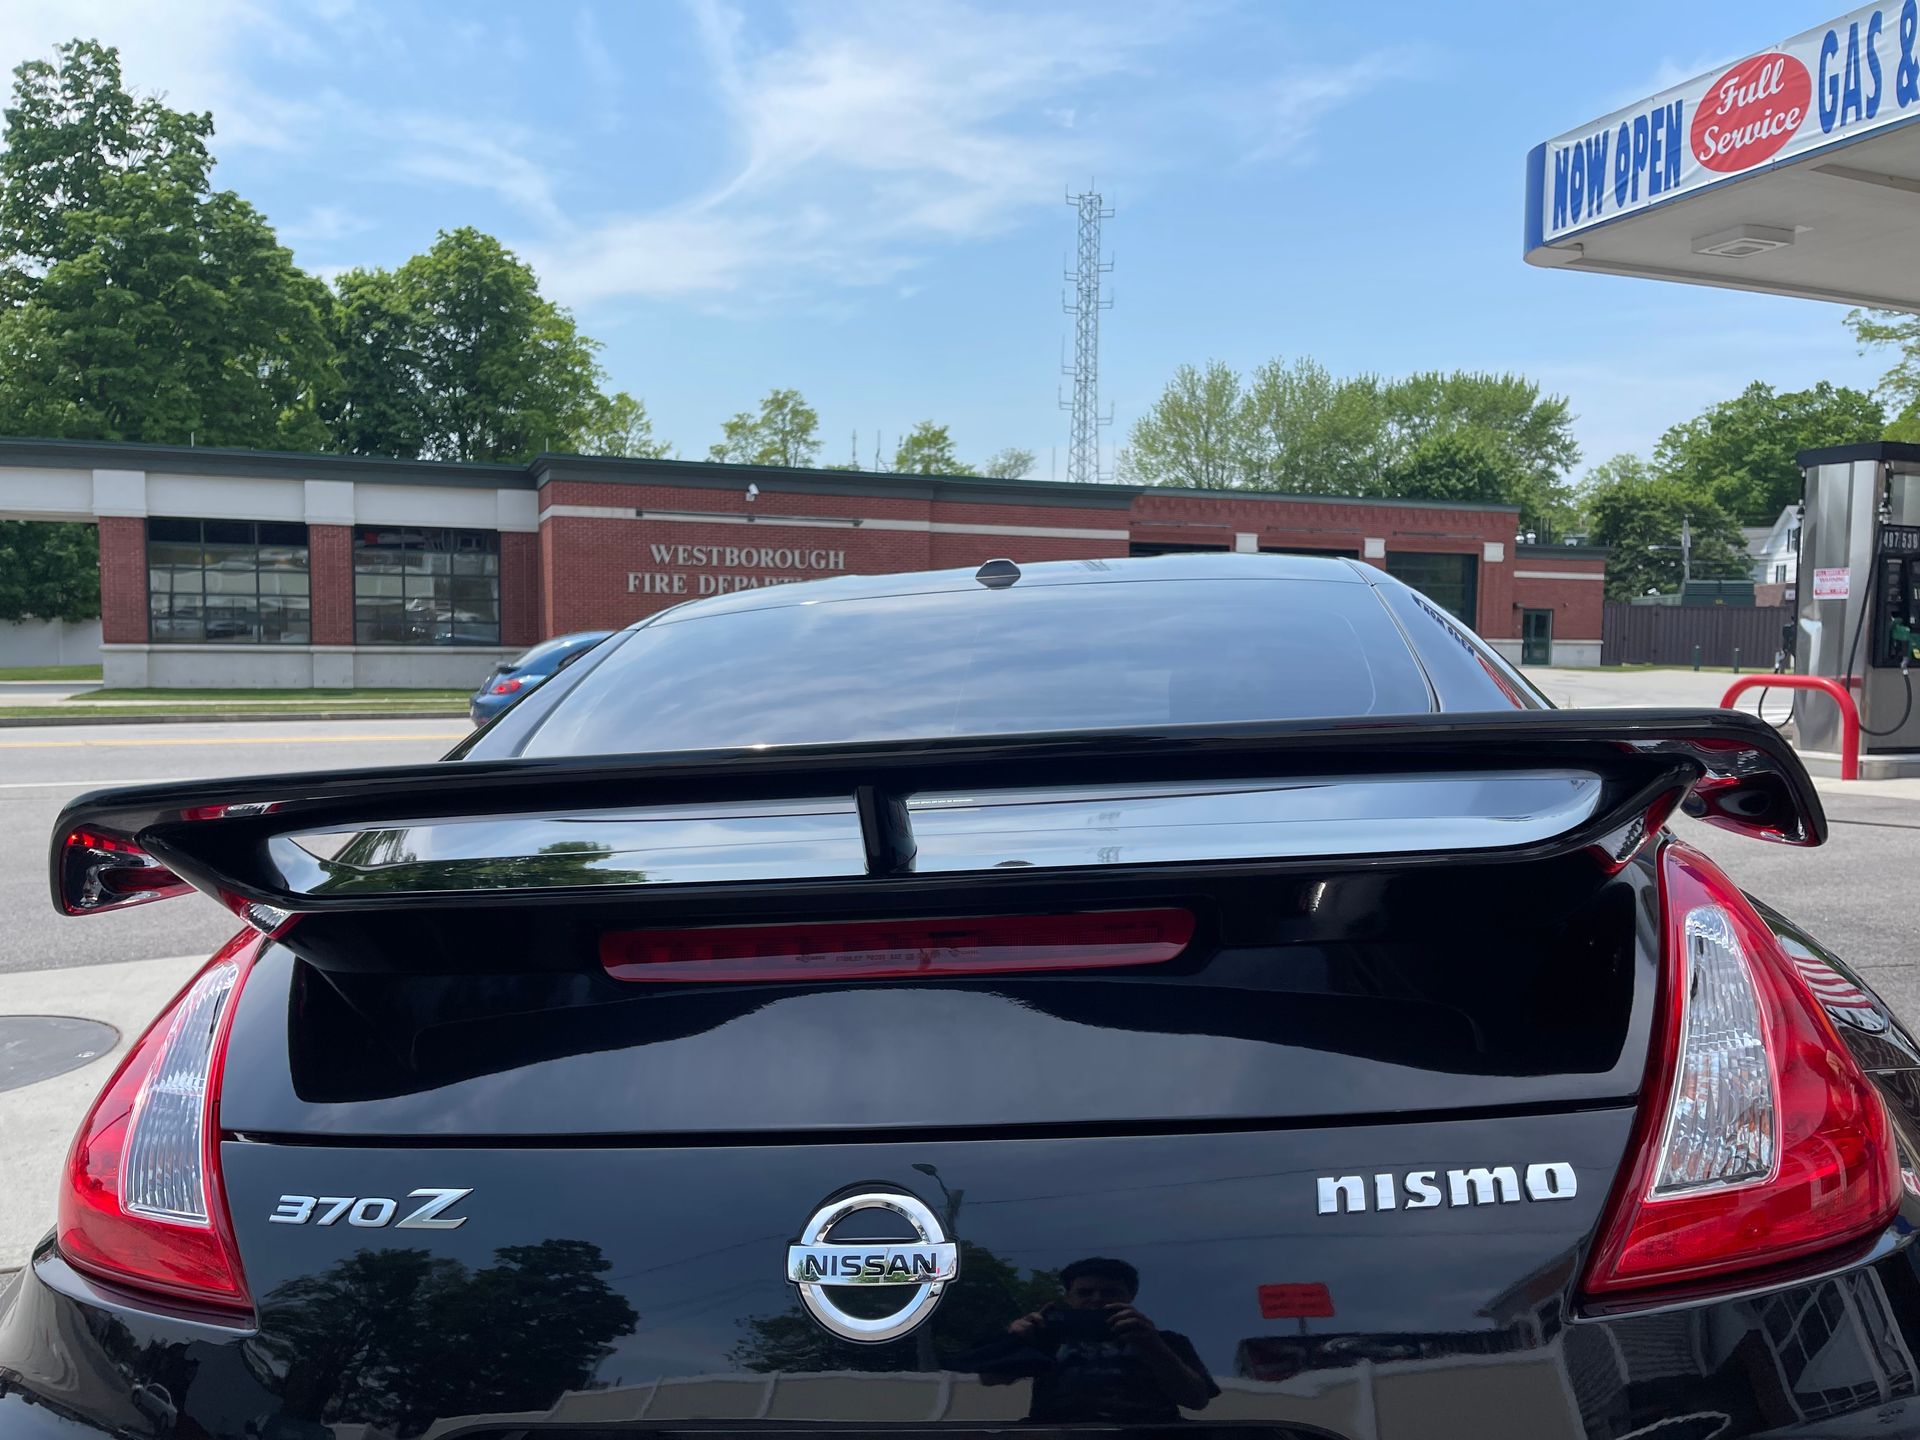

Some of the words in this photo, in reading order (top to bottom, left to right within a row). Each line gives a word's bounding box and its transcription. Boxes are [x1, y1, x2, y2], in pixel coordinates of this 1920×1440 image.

[1715, 58, 1785, 115] Full
[1818, 10, 1883, 134] GAS
[1896, 0, 1919, 108] &
[1699, 104, 1801, 162] Service
[1553, 130, 1609, 230] NOW
[1615, 99, 1683, 208] OPEN
[650, 544, 846, 569] WESTBOROUGH
[627, 572, 688, 594] FIRE
[268, 1188, 474, 1229] 370Z
[804, 1252, 937, 1277] NISSAN
